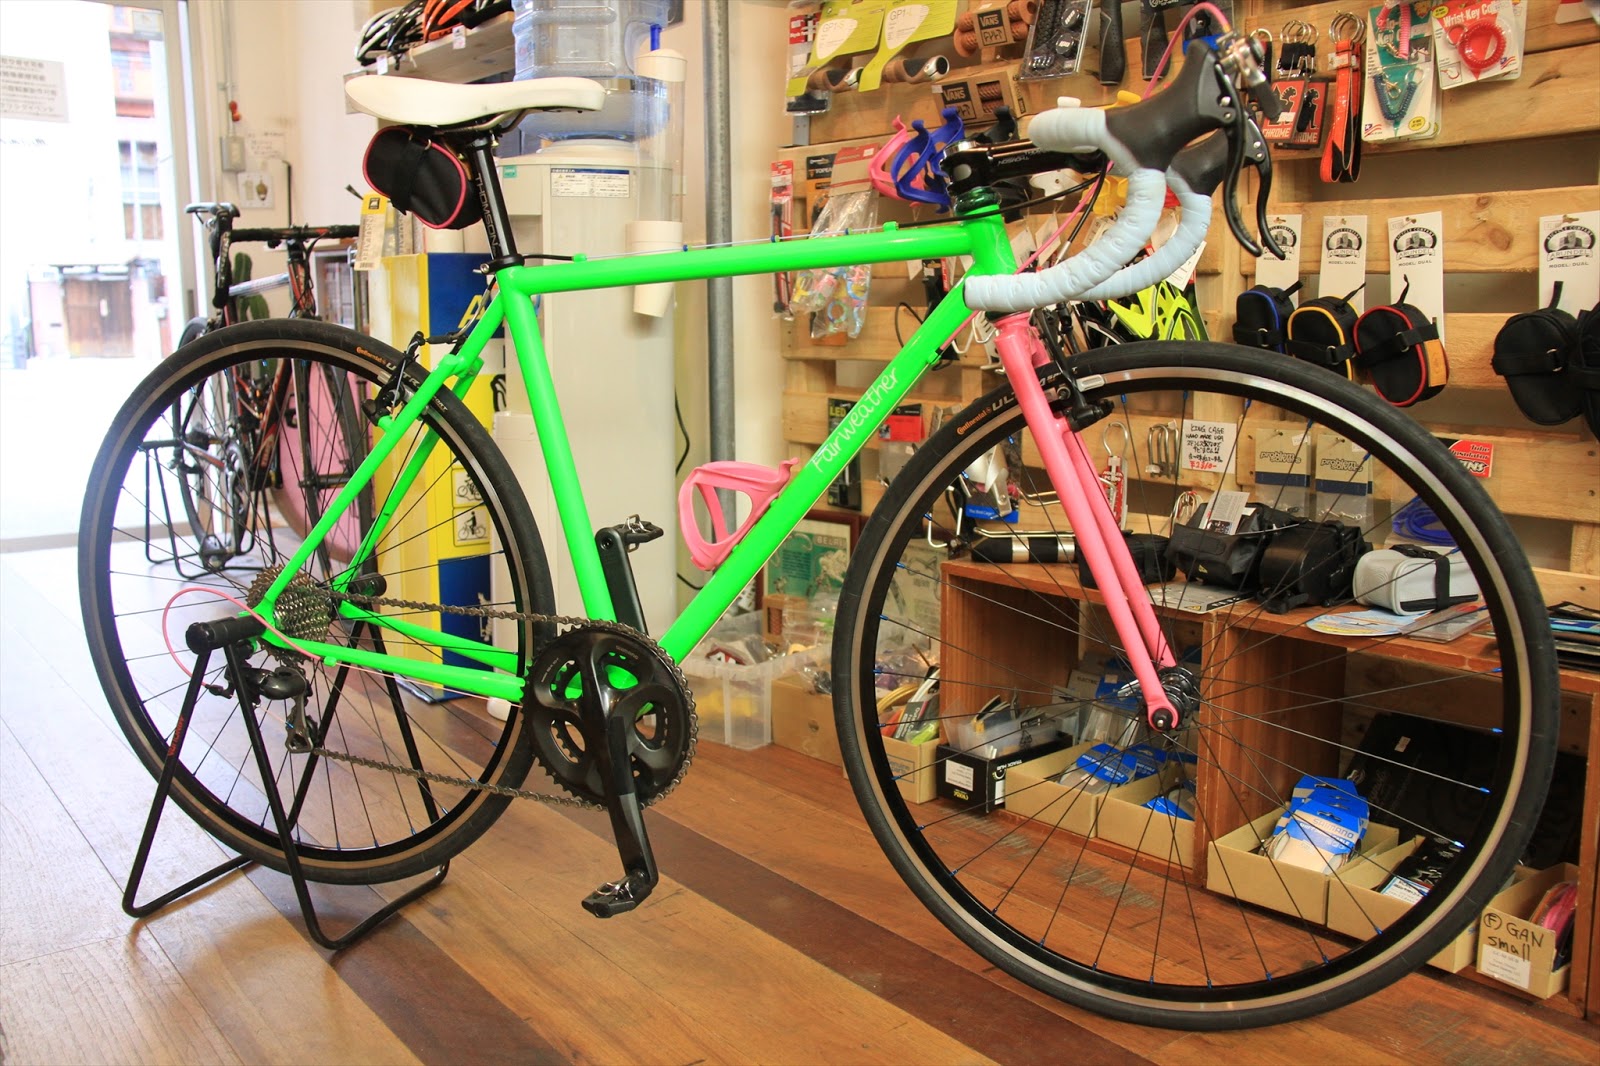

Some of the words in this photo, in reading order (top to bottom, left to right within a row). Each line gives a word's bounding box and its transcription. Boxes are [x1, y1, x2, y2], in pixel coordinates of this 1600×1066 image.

[980, 14, 1000, 27] VANS
[1443, 8, 1480, 27] Wrist-Key
[944, 87, 967, 101] VANS
[1262, 127, 1291, 138] CHROME
[475, 172, 499, 247] THOMSON
[361, 215, 376, 261] INSULATED
[1329, 249, 1359, 257] ARUNDEL
[1399, 249, 1432, 259] ARUNDEL
[1550, 249, 1590, 258] ARUNDEL
[829, 406, 847, 417] LED
[811, 367, 900, 473] Fairweather
[956, 409, 988, 436] Continental
[1191, 424, 1206, 433] KING
[1208, 427, 1225, 435] CAGE
[1260, 450, 1294, 460] problem
[1320, 458, 1356, 468] problem
[1330, 463, 1364, 472] solvers
[1313, 818, 1354, 839] SHIMANO
[1506, 922, 1545, 948] GAN
